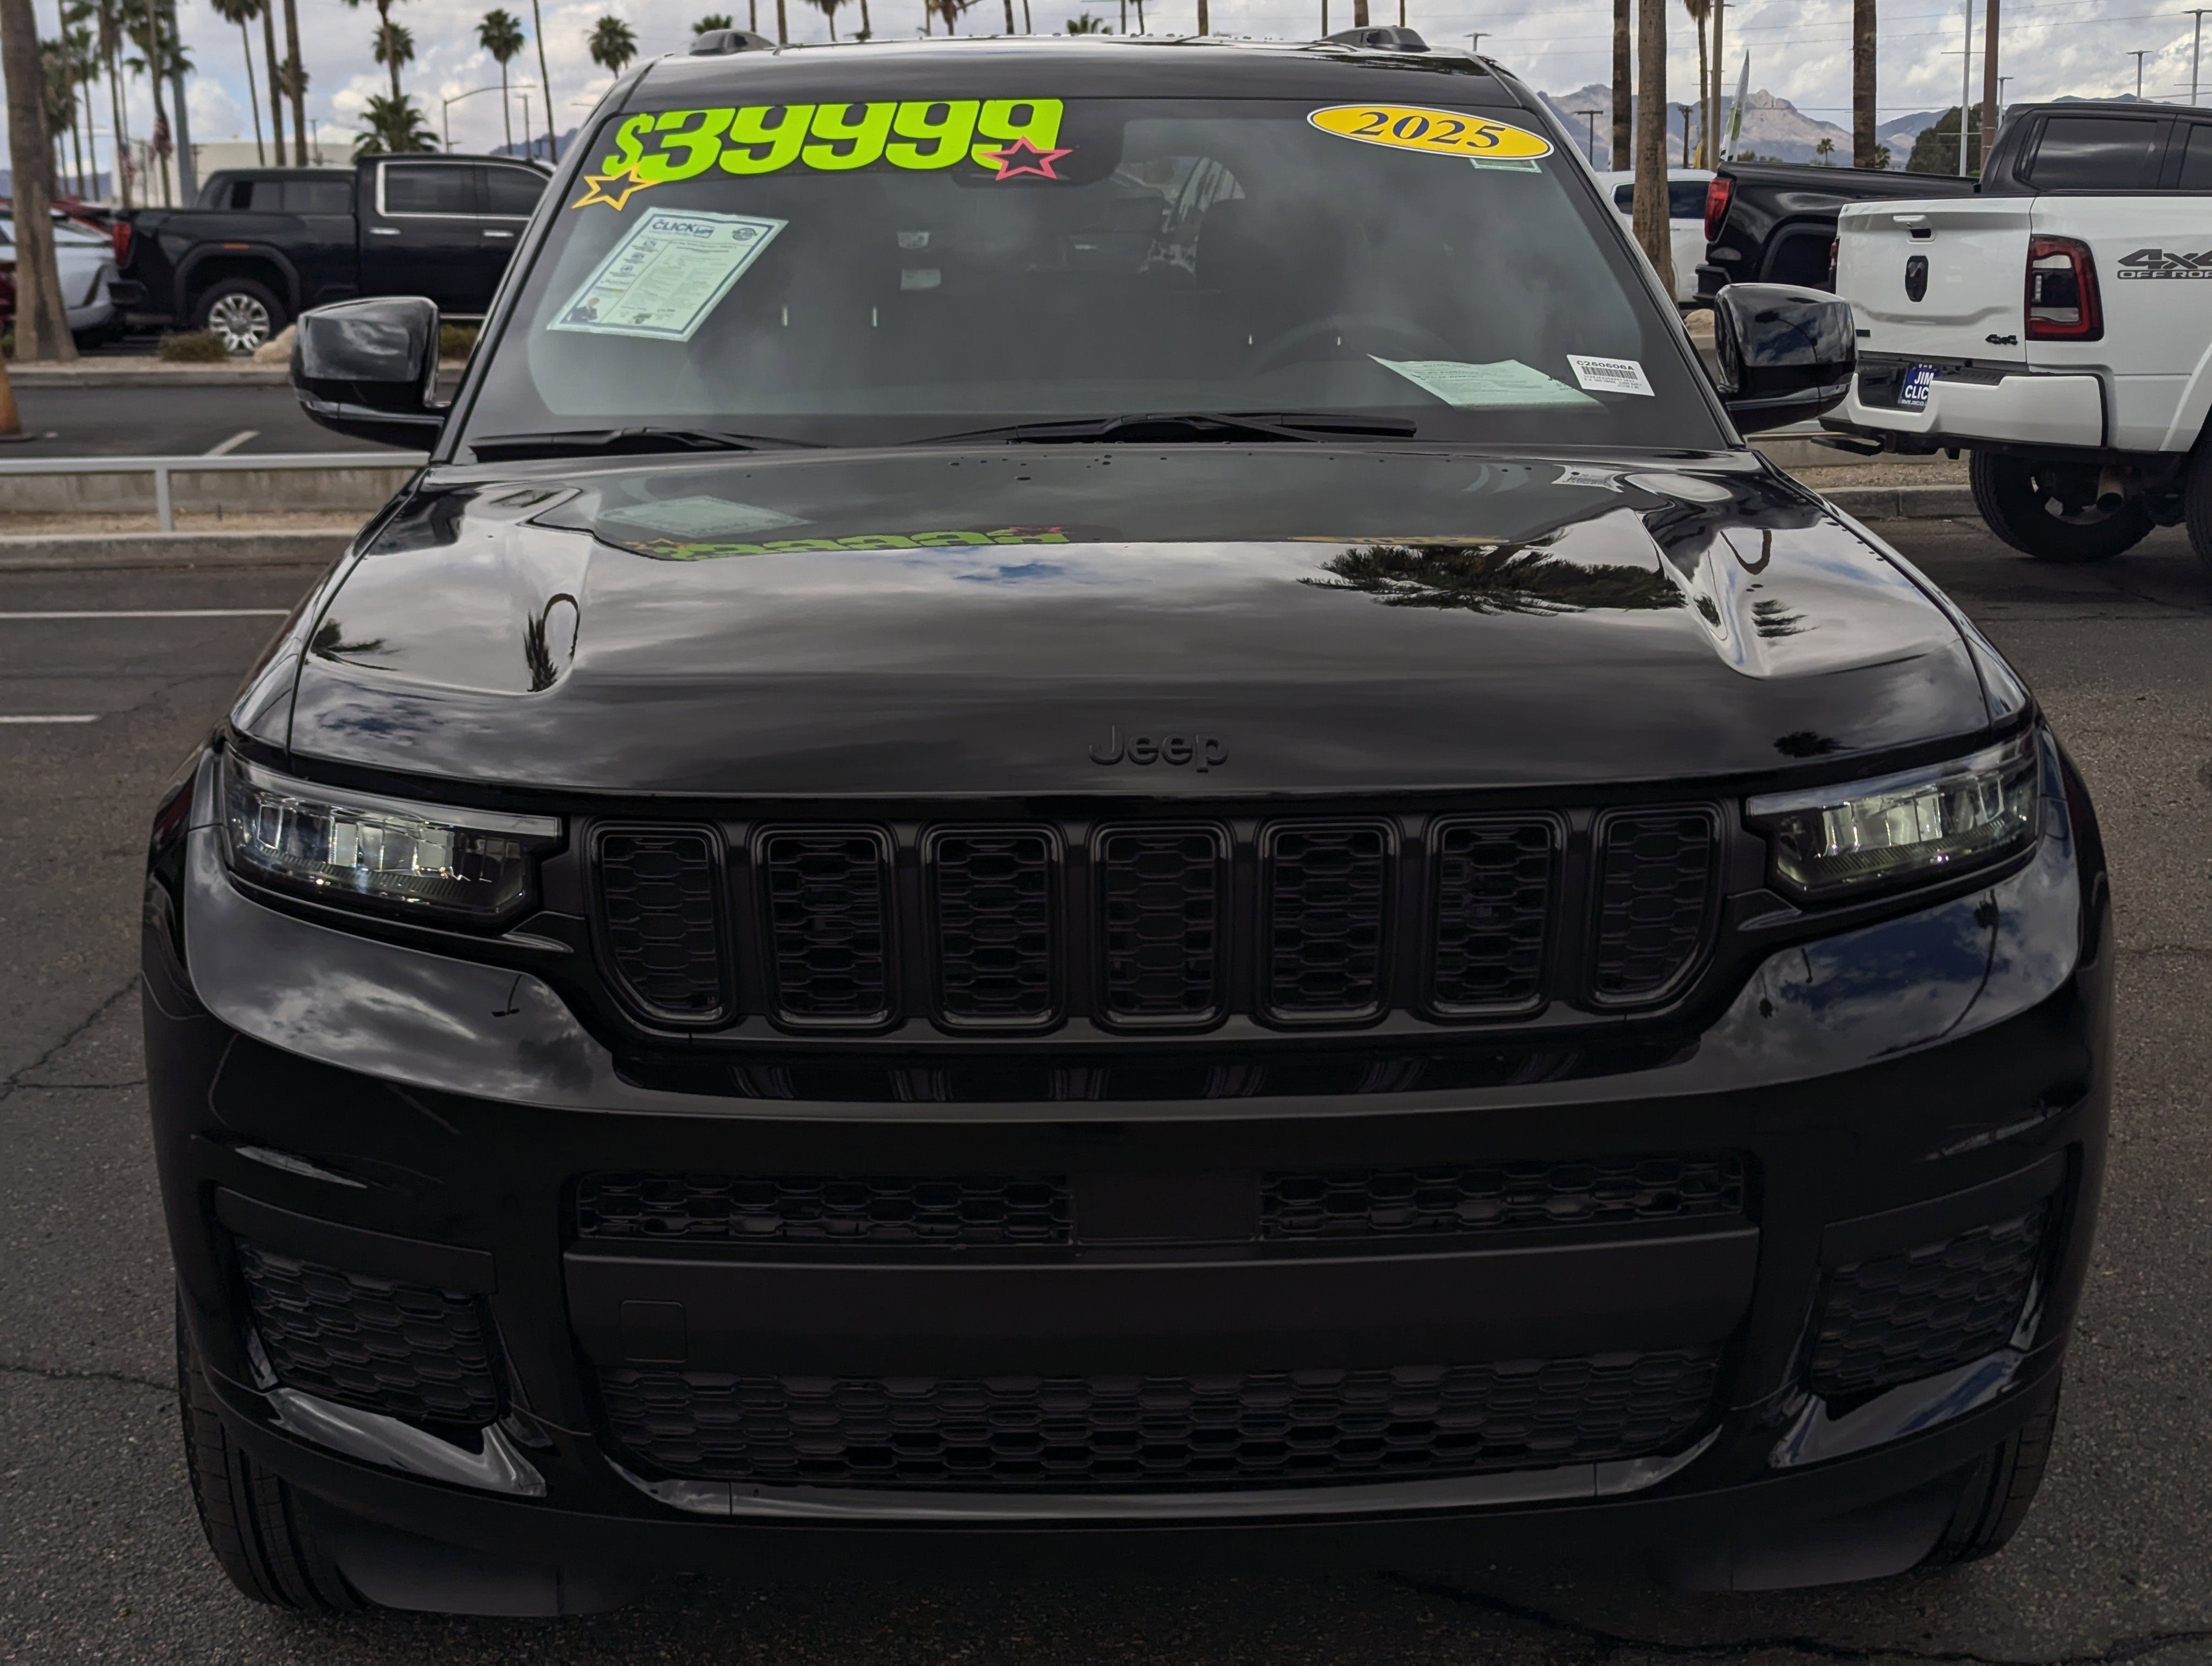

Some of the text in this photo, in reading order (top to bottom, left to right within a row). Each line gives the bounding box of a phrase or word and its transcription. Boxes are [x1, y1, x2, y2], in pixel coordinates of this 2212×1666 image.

[602, 98, 1063, 183] $39999
[1349, 111, 1506, 148] 2025
[652, 221, 698, 233] CLICK
[1914, 371, 1934, 386] JIM
[1905, 385, 1929, 400] CLIC
[1089, 725, 1229, 773] Jeep
